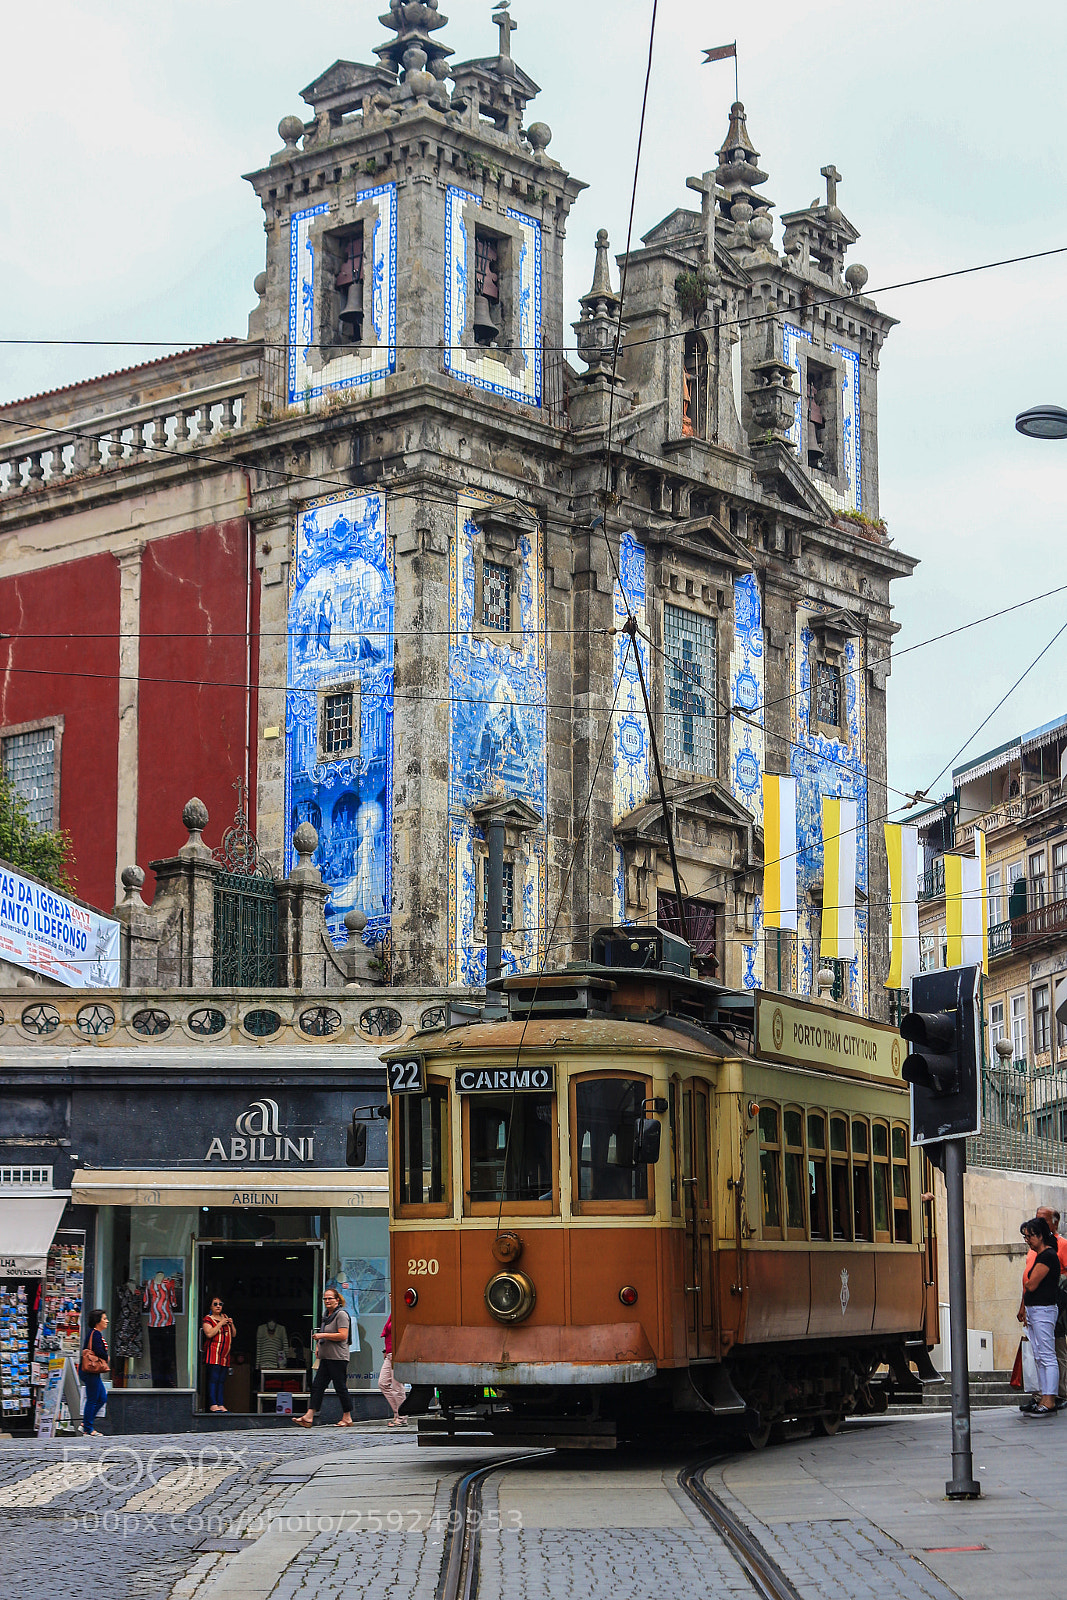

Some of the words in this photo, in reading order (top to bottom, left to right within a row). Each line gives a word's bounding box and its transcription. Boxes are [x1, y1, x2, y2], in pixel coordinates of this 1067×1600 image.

[19, 881, 33, 907] DA
[36, 889, 71, 923] IGREJA
[70, 906, 90, 925] 2017
[34, 910, 87, 952] ILDEFONSO
[793, 1022, 822, 1048] PORTO
[823, 1029, 841, 1053] TRAM
[843, 1034, 861, 1056] CITY
[861, 1038, 877, 1062] TOUR
[391, 1061, 420, 1090] 22
[460, 1070, 549, 1090] CARMO
[204, 1137, 314, 1161] ABILINI
[232, 1193, 278, 1205] ABILINI
[1, 1259, 16, 1268] LHA
[408, 1258, 439, 1275] 220
